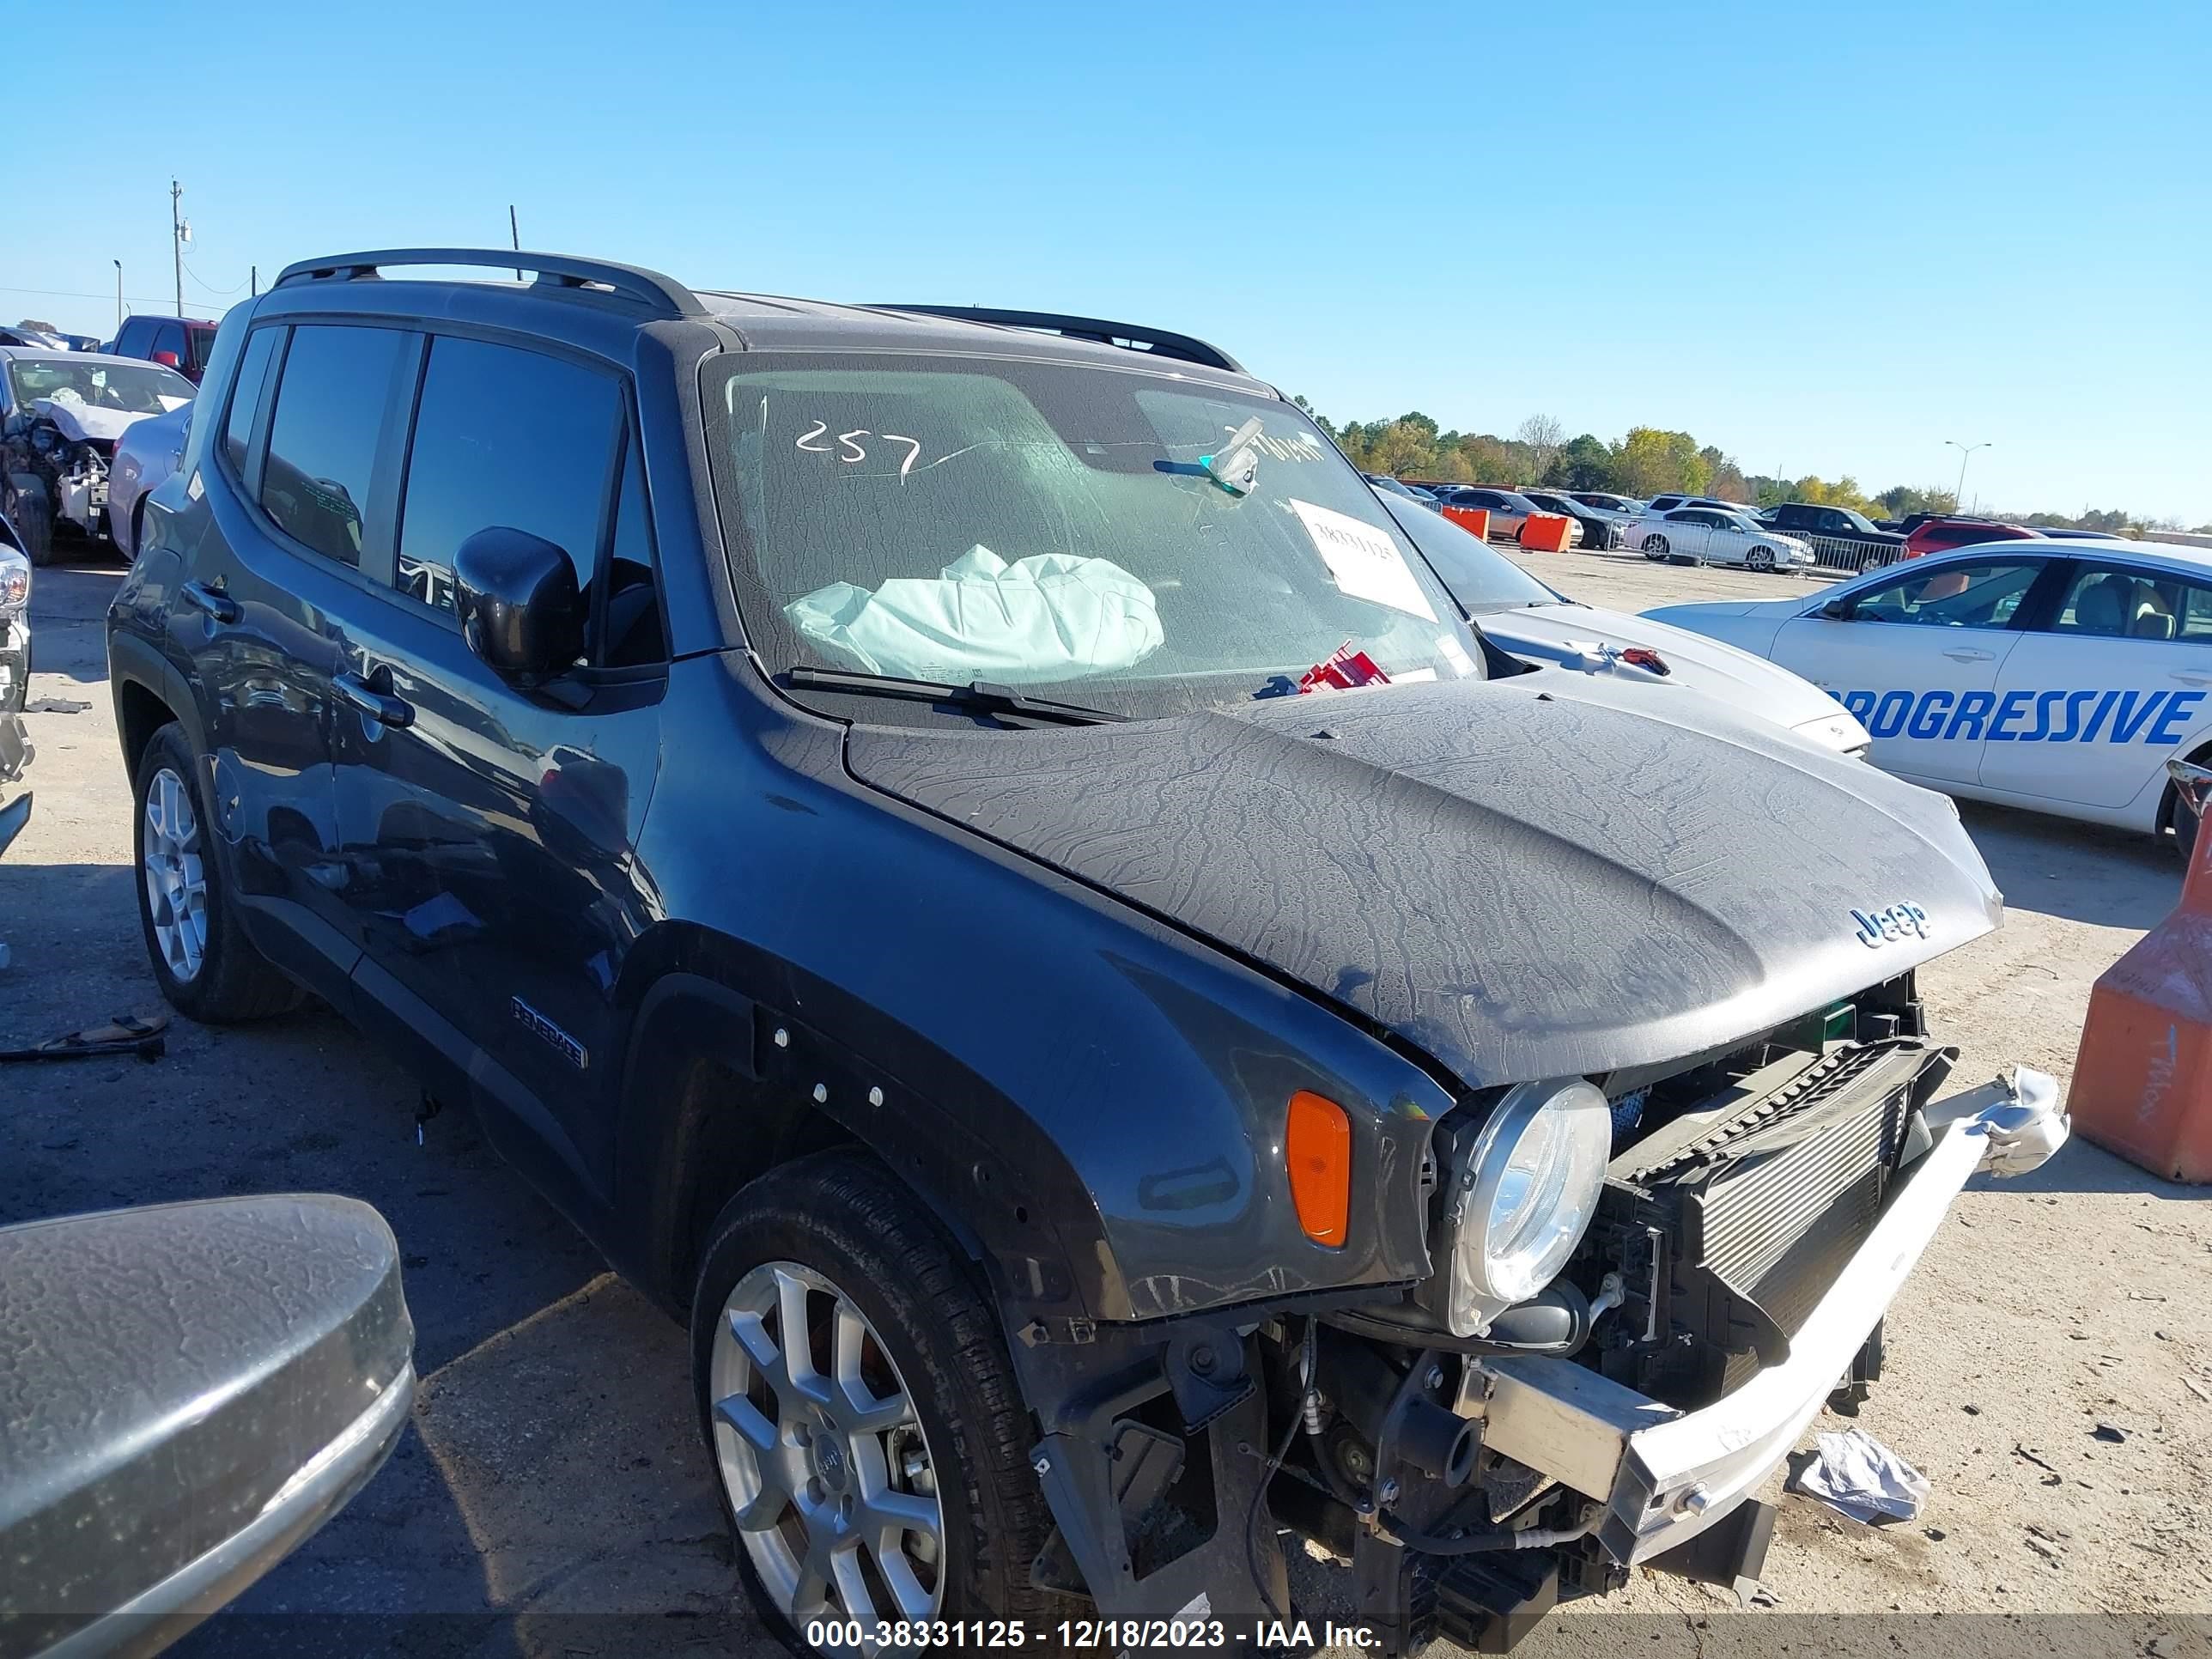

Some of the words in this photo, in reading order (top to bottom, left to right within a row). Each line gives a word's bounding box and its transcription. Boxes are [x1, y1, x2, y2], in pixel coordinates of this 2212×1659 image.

[796, 420, 921, 485] 257
[1826, 690, 2207, 744] ROGRESSIVE
[1849, 900, 1931, 949] Jeep
